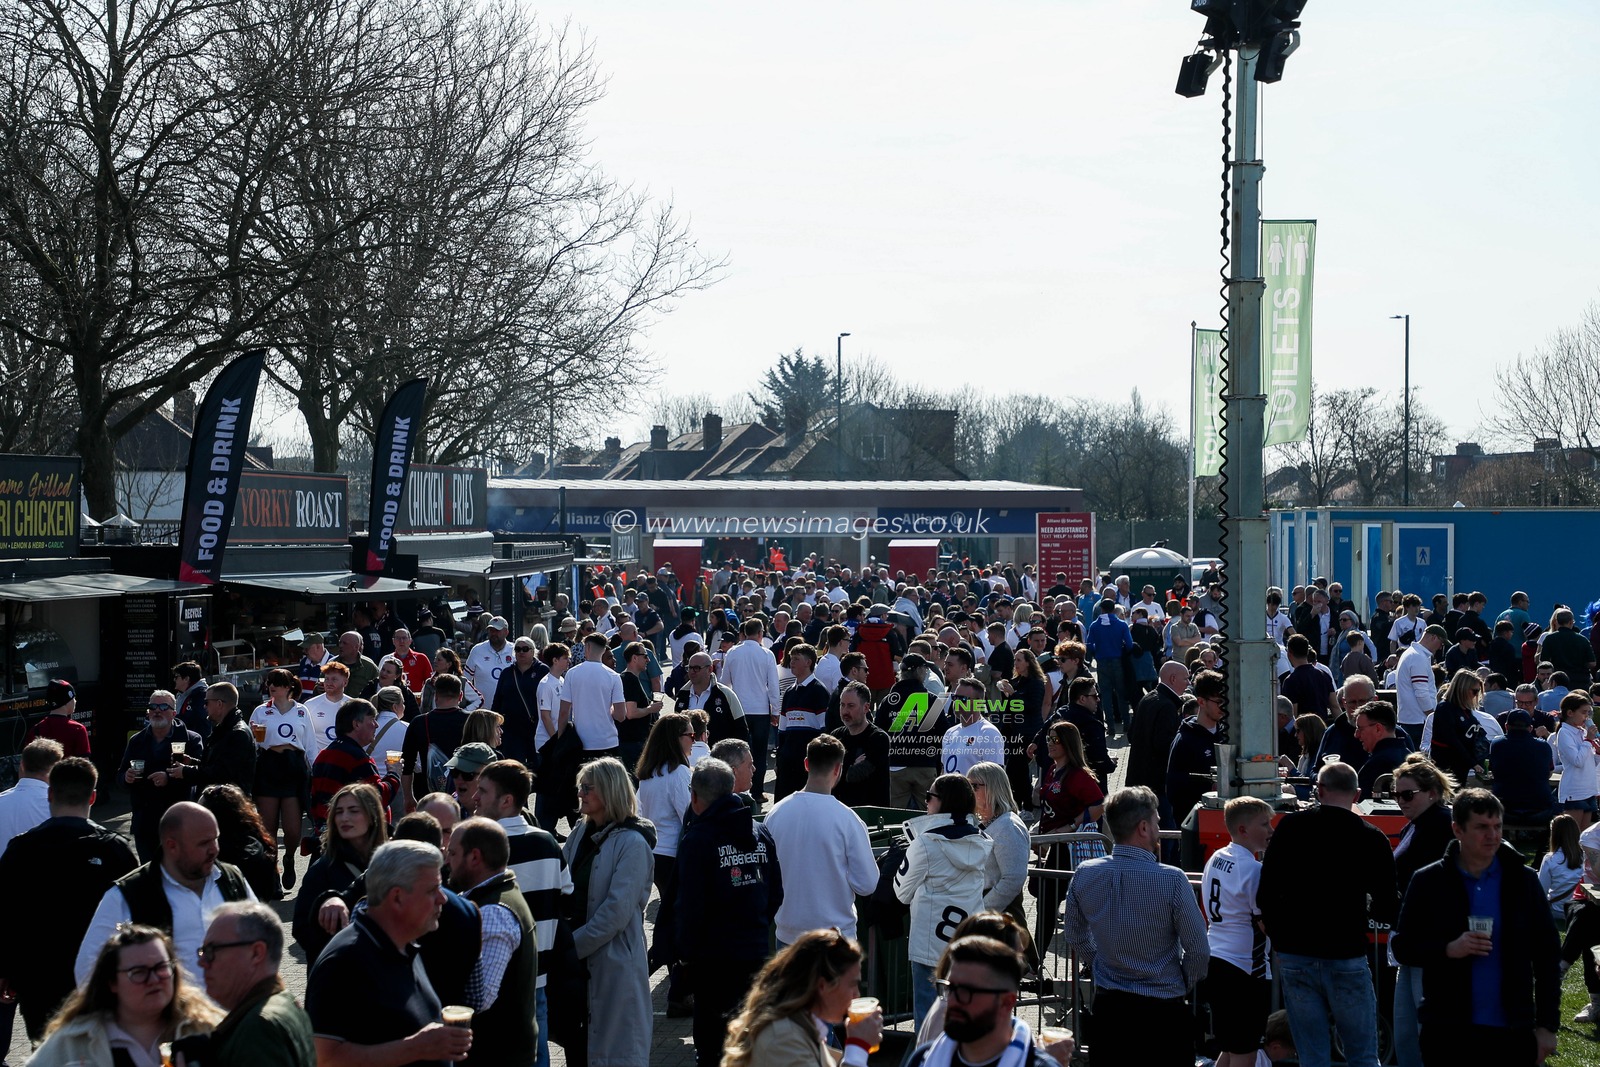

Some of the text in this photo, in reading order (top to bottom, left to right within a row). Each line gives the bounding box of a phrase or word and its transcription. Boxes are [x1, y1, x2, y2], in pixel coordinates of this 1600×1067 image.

[1271, 287, 1301, 434] TOILETS
[210, 397, 242, 472] DRINK
[1203, 373, 1218, 468] TOILETS
[388, 416, 411, 478] DRINK
[0, 472, 74, 500] ame Grilled
[207, 477, 228, 495] &
[386, 482, 402, 496] &
[408, 470, 444, 527] CHICKEN
[452, 473, 474, 526] FRIES
[14, 500, 75, 537] CHICKEN
[239, 487, 342, 528] YORKY ROAST
[551, 512, 601, 525] Alianz
[902, 513, 948, 525] Allianz
[198, 500, 225, 561] FOOD
[380, 500, 398, 550] FOOD
[11, 542, 28, 550] LEMON
[32, 541, 46, 549] HERB
[48, 541, 65, 549] GARLIC
[617, 535, 635, 560] PIZZA
[185, 607, 202, 619] RECYCLE
[189, 621, 199, 632] HERE
[1212, 857, 1236, 874] WHITE
[1209, 877, 1223, 923] 8
